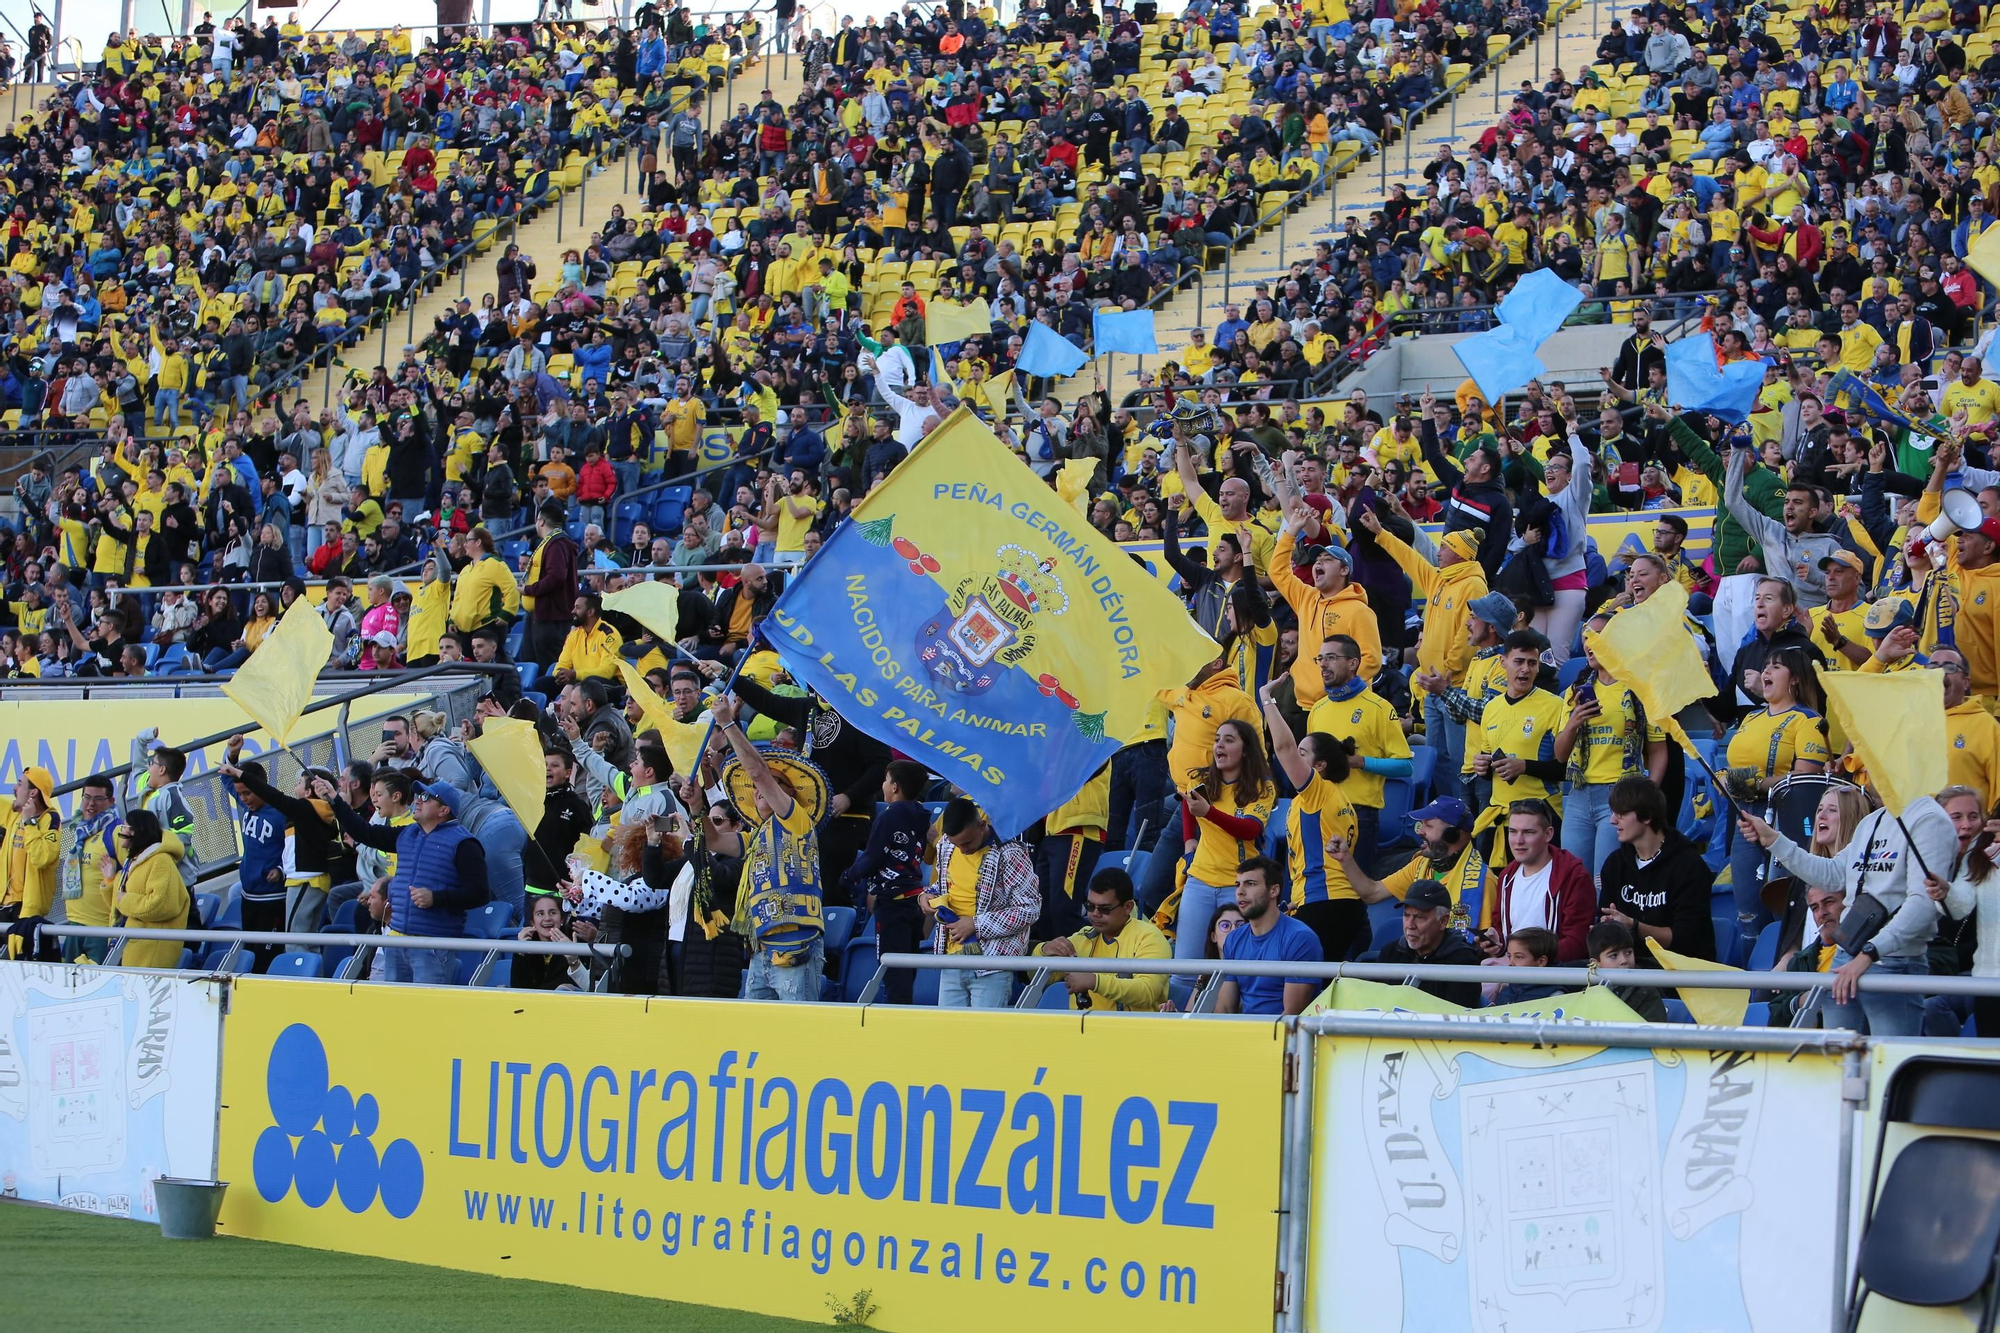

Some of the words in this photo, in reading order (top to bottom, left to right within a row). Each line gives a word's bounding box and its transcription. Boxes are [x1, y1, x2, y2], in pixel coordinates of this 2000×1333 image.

[934, 482, 1003, 510] PEÑA
[1010, 502, 1100, 577] GERMÁN
[1091, 575, 1141, 679] DÉVORA
[982, 577, 1000, 601] LAS
[995, 598, 1034, 631] PALMAS
[845, 574, 900, 680] NACIDOS
[894, 675, 948, 718] PARA
[949, 708, 1047, 738] ANIMAR
[819, 651, 879, 707] LAS
[881, 706, 1006, 786] PALMAS
[1588, 735, 1623, 747] anaria
[1067, 840, 1080, 880] ACERBIS
[465, 1191, 1196, 1304] www.litografiagonzalez.com
